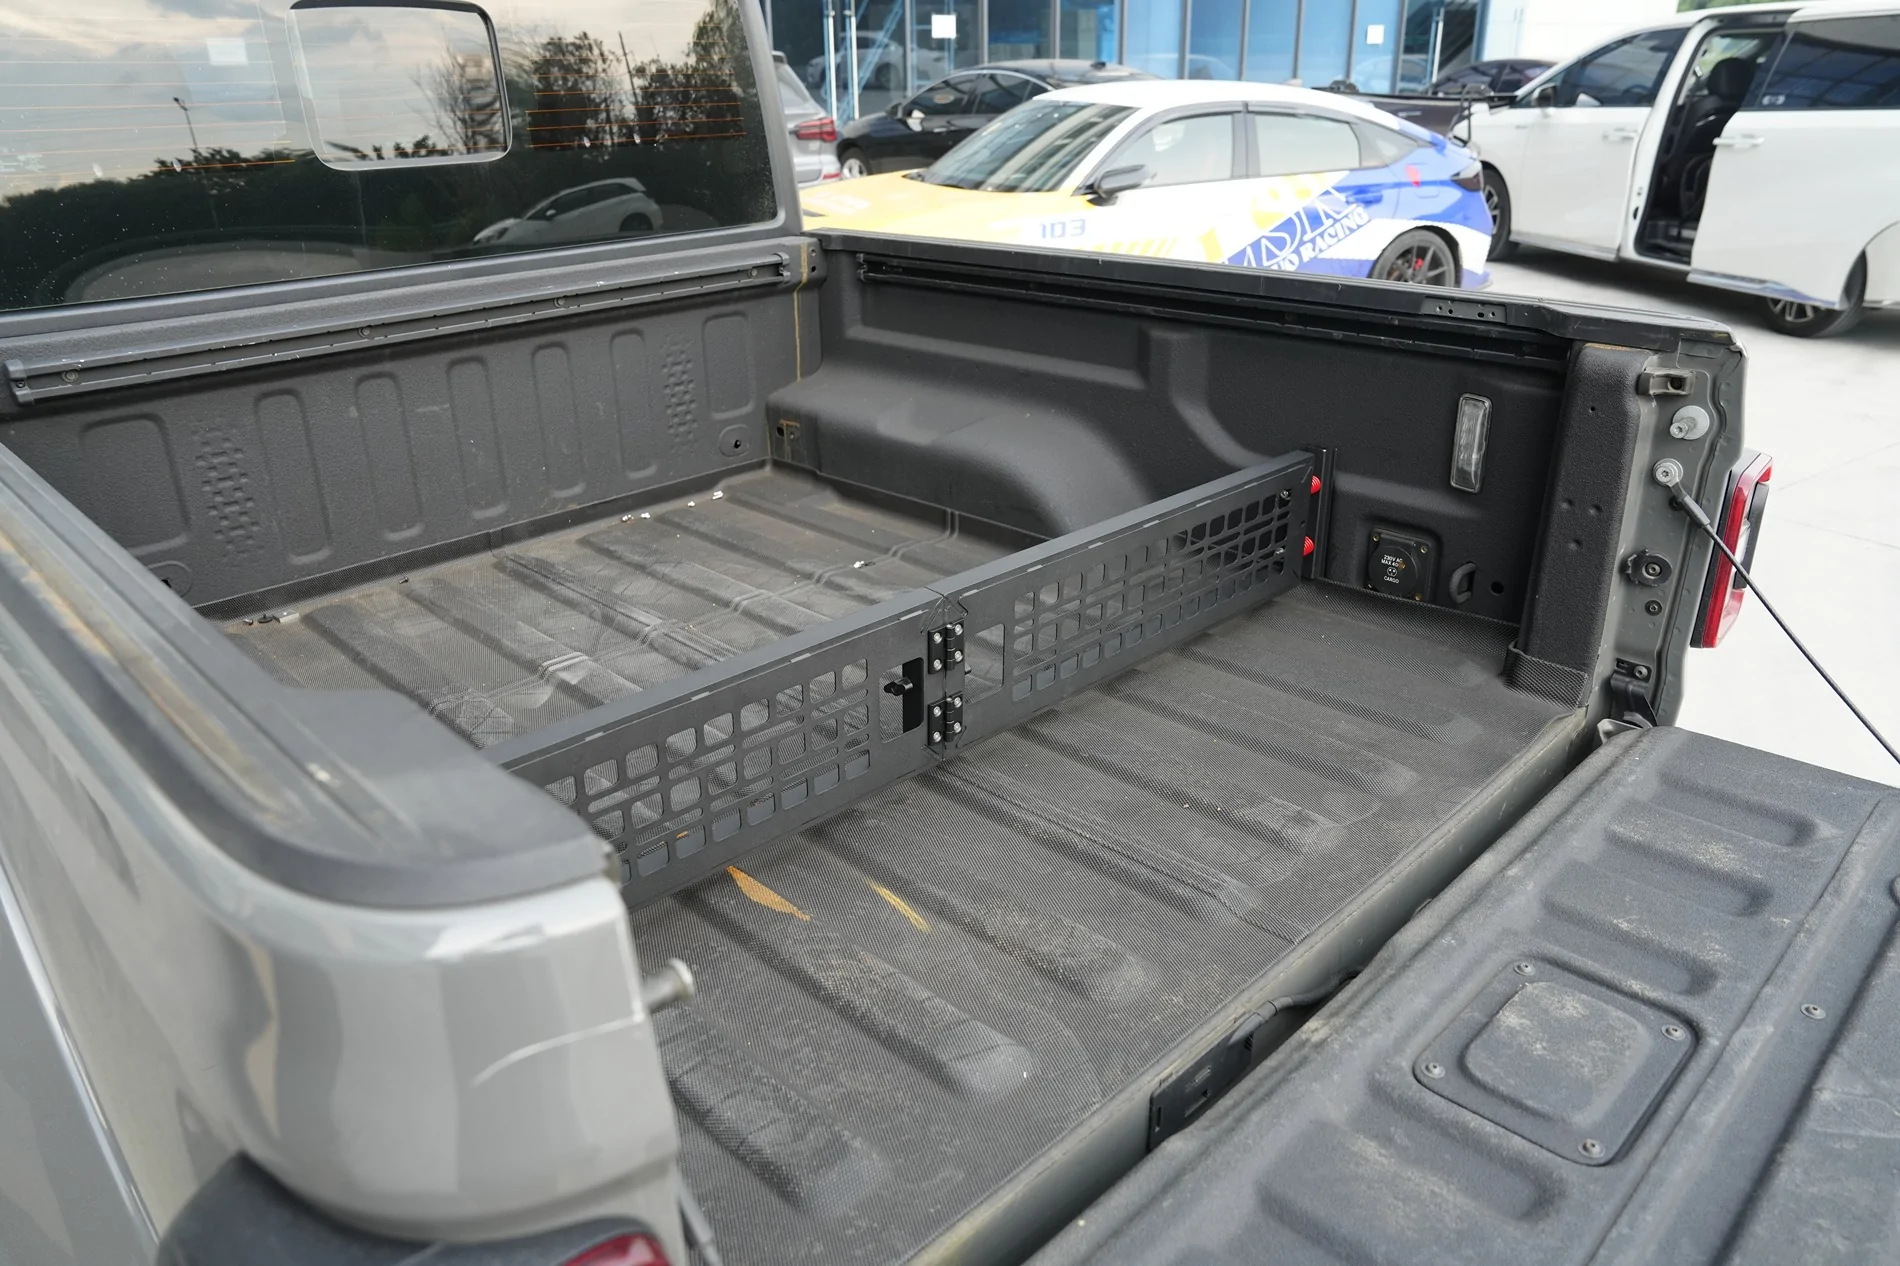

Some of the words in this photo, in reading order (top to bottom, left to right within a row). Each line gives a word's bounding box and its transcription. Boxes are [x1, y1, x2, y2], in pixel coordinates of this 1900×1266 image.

[1040, 218, 1086, 239] 103
[1300, 206, 1371, 263] RACING
[1381, 558, 1391, 566] MAX
[1384, 575, 1399, 584] CARGO
